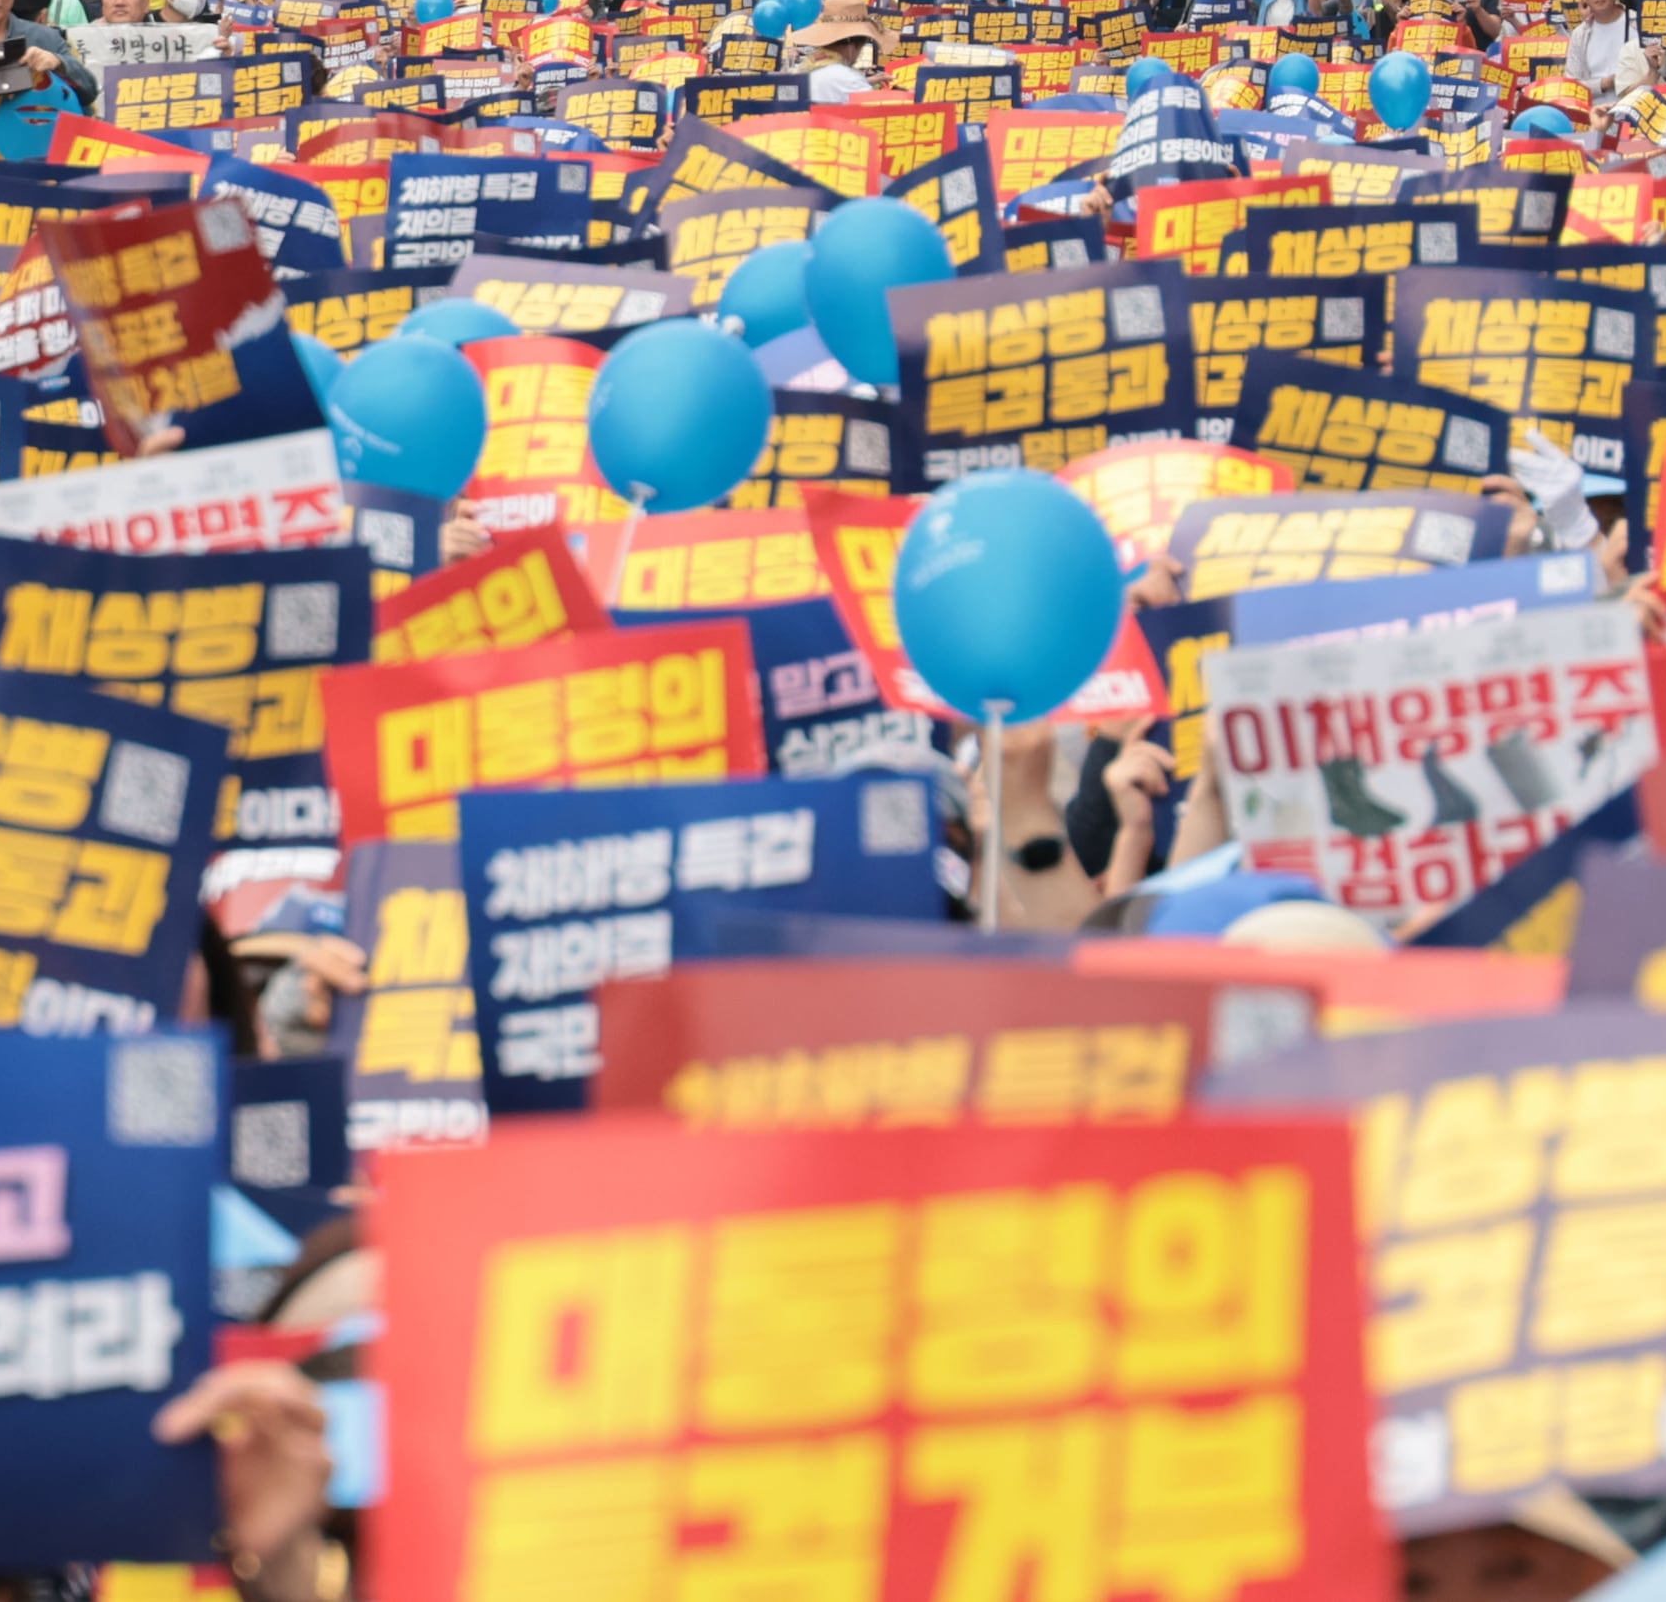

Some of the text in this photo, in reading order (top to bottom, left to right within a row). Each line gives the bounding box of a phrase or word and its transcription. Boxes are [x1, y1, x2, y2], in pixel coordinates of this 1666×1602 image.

[1147, 37, 1212, 58] 대통령의
[116, 73, 197, 105] 채상병
[396, 207, 475, 237] 재의결
[400, 172, 539, 207] 채해병 특검
[927, 289, 1105, 378] 채상병
[1417, 297, 1592, 362] 채상병
[1048, 342, 1170, 425] 통과
[1257, 385, 1446, 468] 채상병
[0, 583, 264, 675] 채상병
[378, 648, 727, 806] 대통령의
[677, 809, 814, 891] 특검
